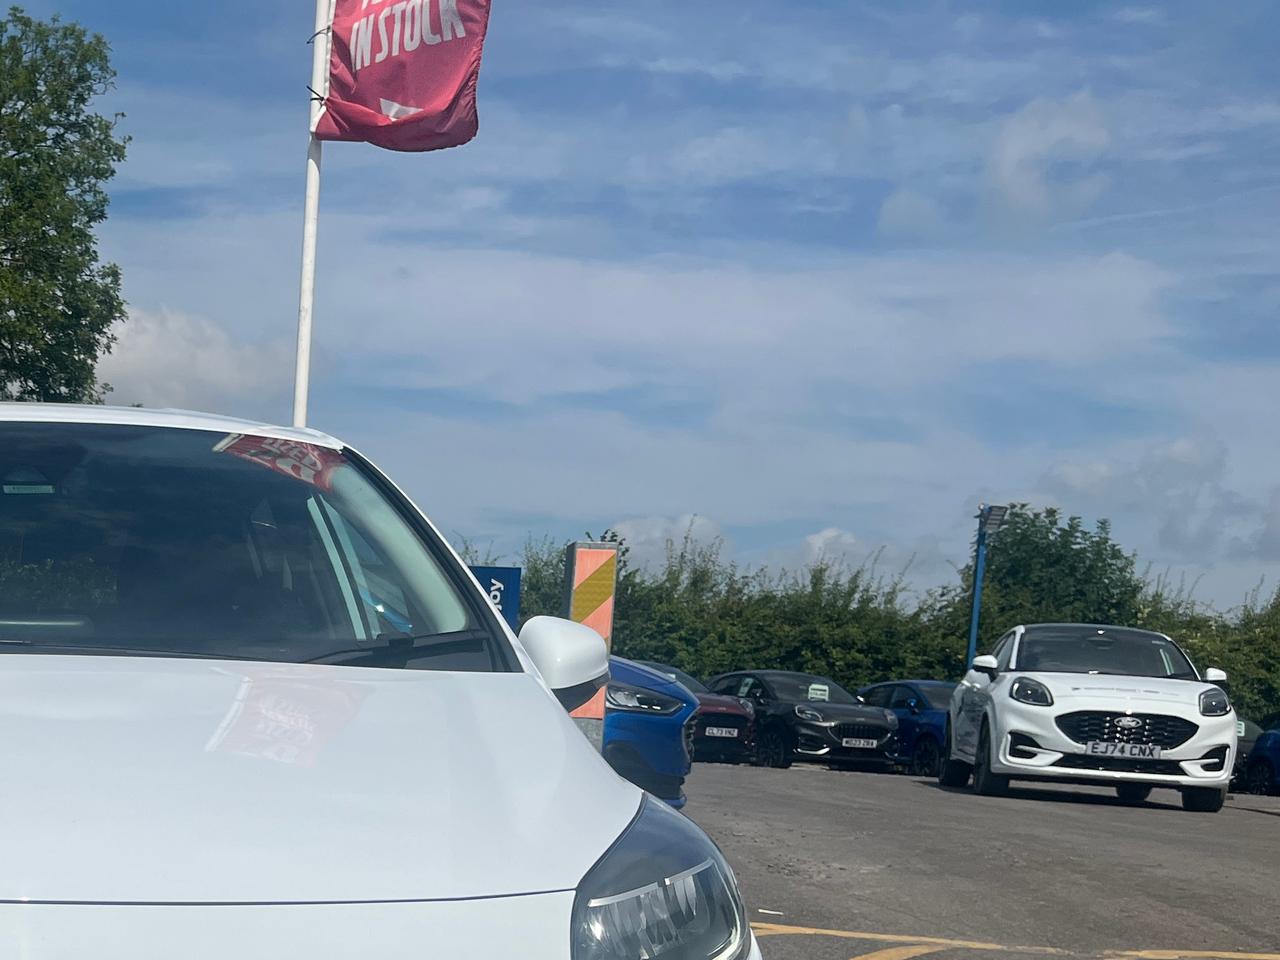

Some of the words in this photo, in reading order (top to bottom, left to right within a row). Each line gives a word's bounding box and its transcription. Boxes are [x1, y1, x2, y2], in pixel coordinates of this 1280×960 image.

[375, 0, 466, 63] STOCK
[1091, 742, 1125, 755] EJ74
[1129, 745, 1156, 757] CNX
